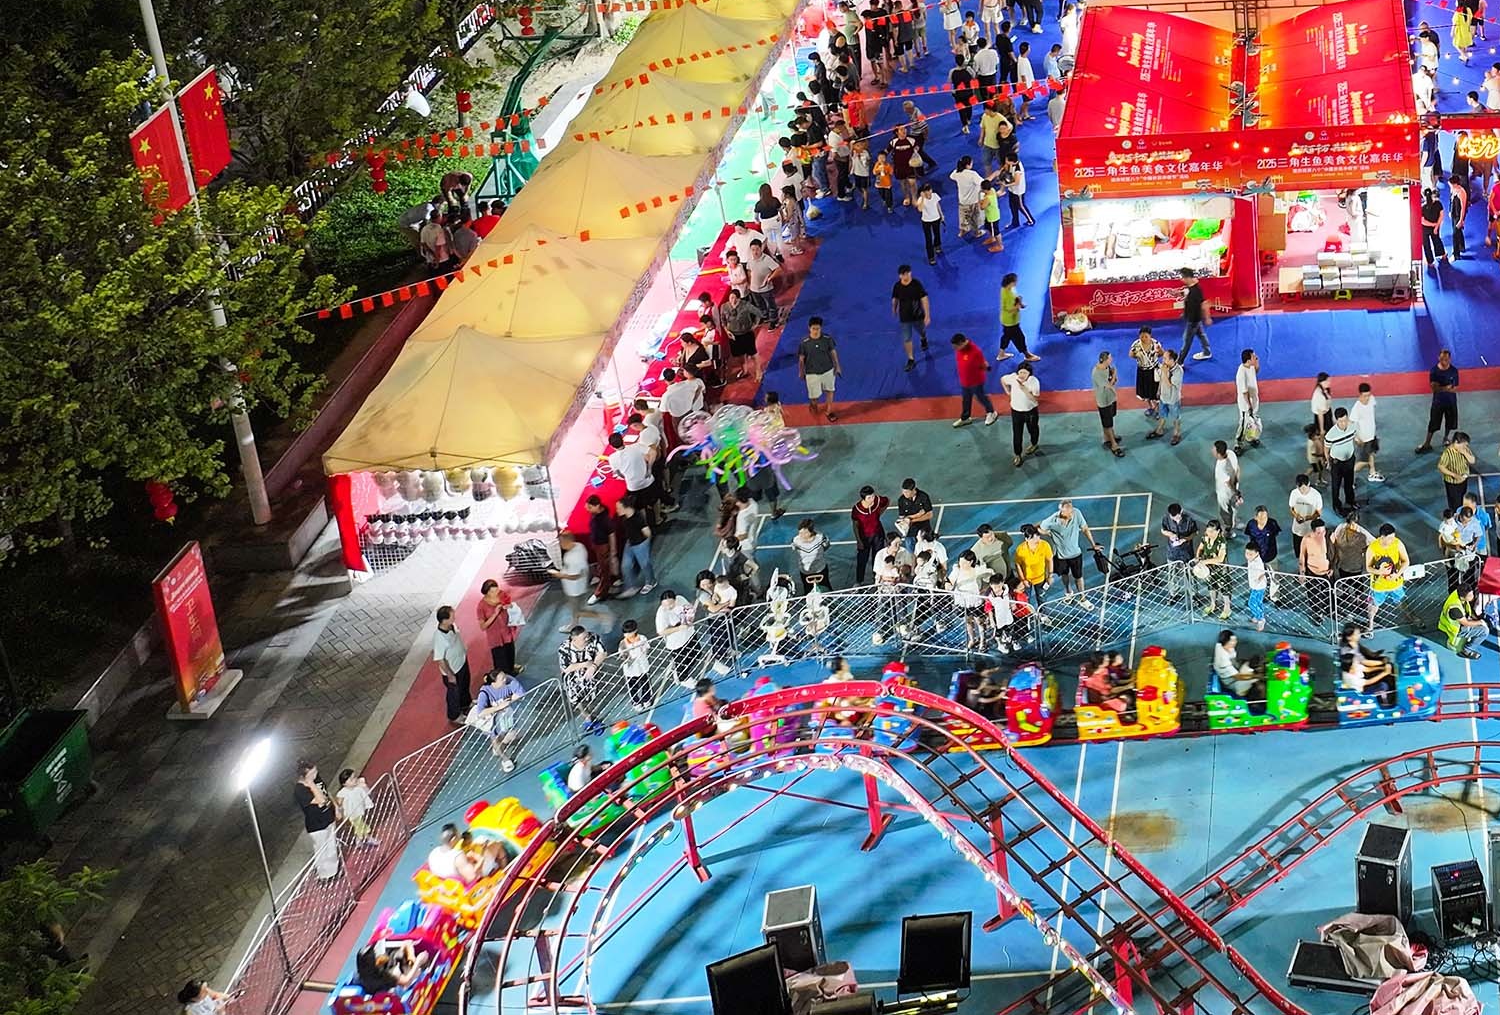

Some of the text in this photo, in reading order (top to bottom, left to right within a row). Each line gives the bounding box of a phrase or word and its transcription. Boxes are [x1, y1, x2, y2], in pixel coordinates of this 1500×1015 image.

[1074, 160, 1224, 178] 2025三角生鱼美食文化嘉年华
[1257, 152, 1404, 169] 2025三角生鱼美食文化嘉年华
